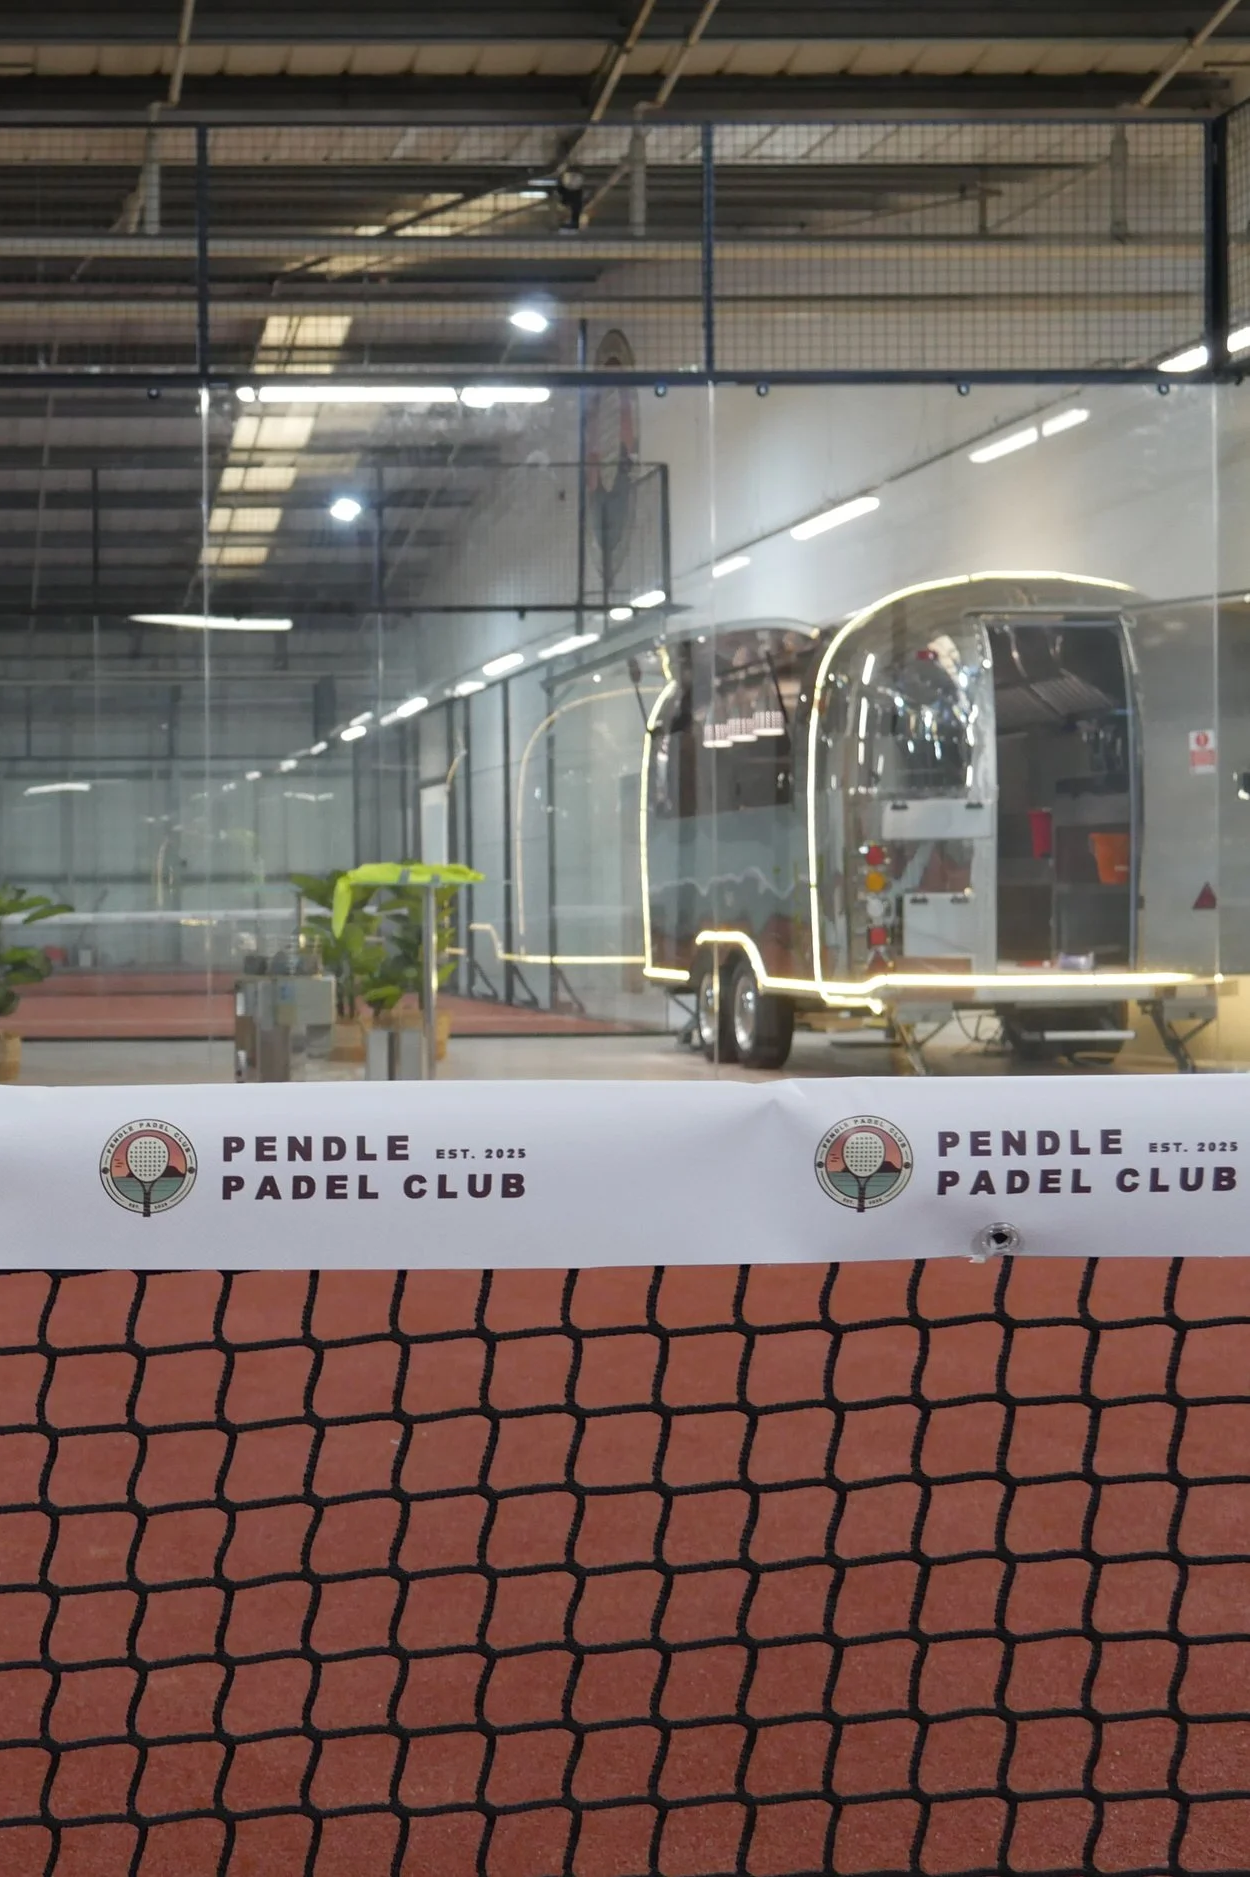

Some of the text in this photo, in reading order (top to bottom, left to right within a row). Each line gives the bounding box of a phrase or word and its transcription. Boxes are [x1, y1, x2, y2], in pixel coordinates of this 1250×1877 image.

[106, 1122, 191, 1154] PENDLE PADEL CLUB
[822, 1118, 908, 1150] PENDLE PADEL CLUB
[938, 1128, 1238, 1157] PENDLE EST. 2025
[222, 1135, 526, 1163] PENDLE EST. 2025
[221, 1173, 526, 1201] PADEL CLUB
[936, 1166, 1237, 1196] PADEL CLUB
